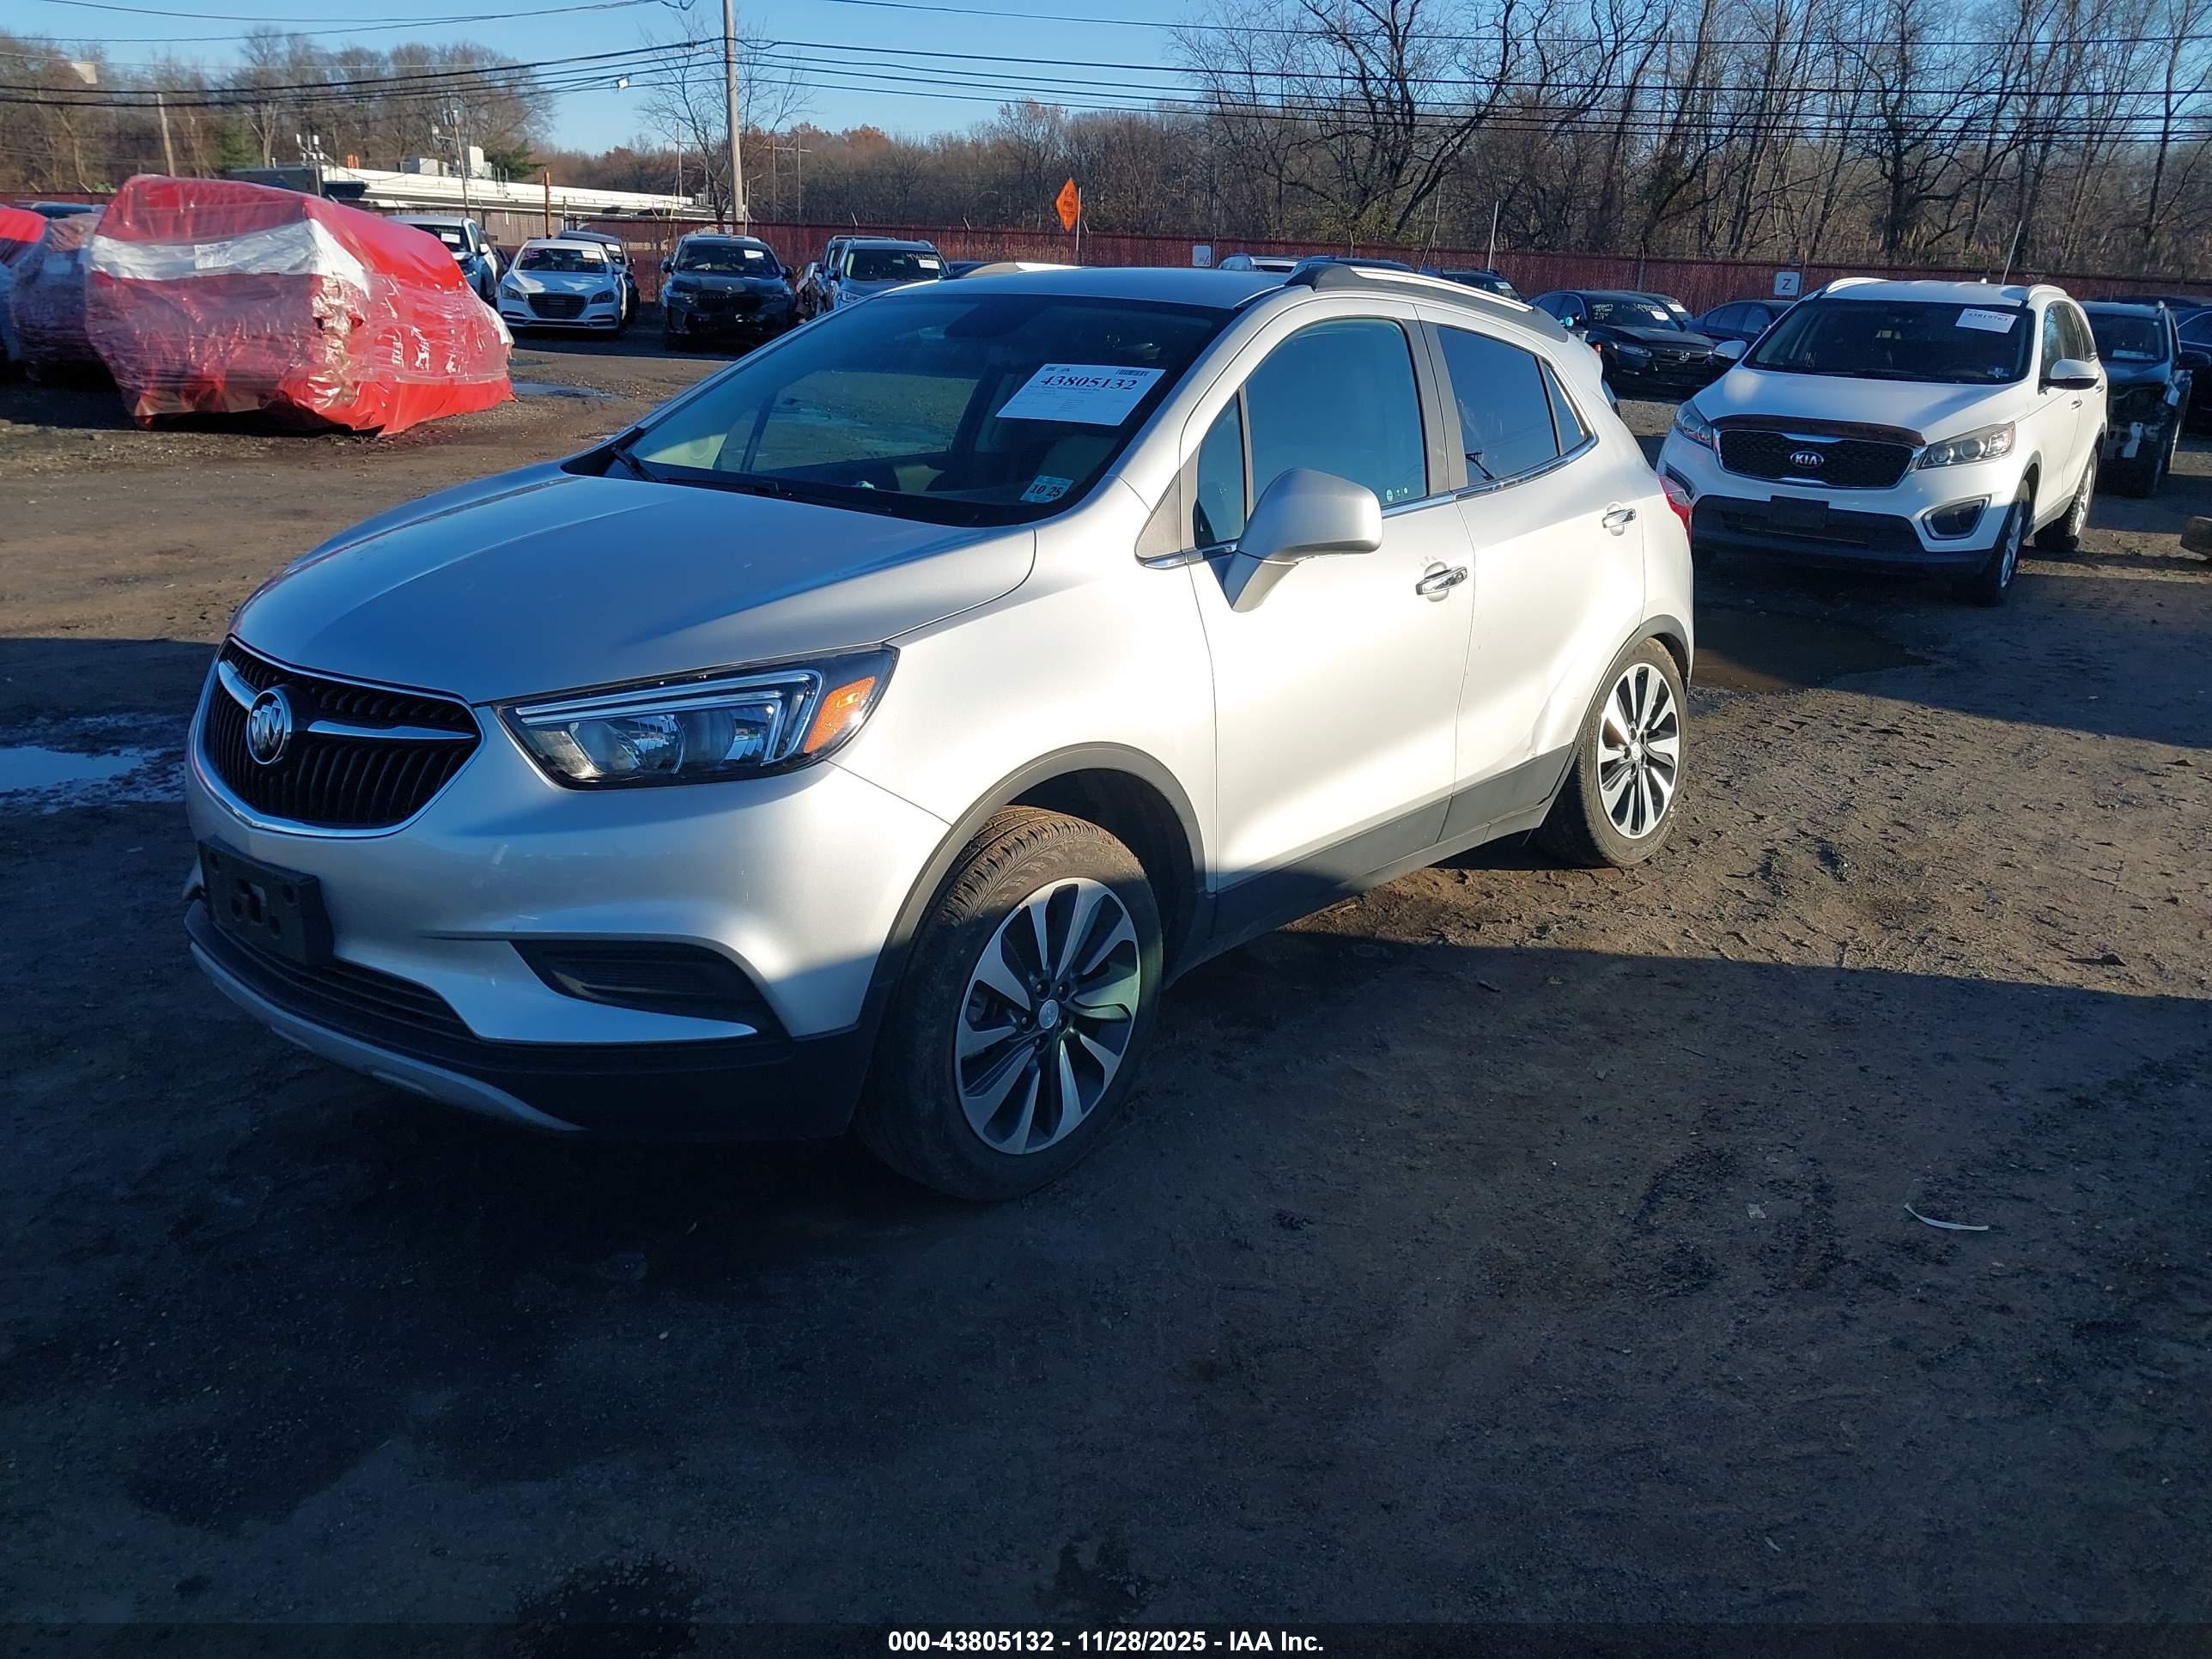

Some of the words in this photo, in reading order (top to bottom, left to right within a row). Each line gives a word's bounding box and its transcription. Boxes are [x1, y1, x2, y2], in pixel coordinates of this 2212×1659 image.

[1781, 278, 1792, 290] Z
[1040, 375, 1138, 390] 43805132
[1795, 454, 1818, 465] KIA
